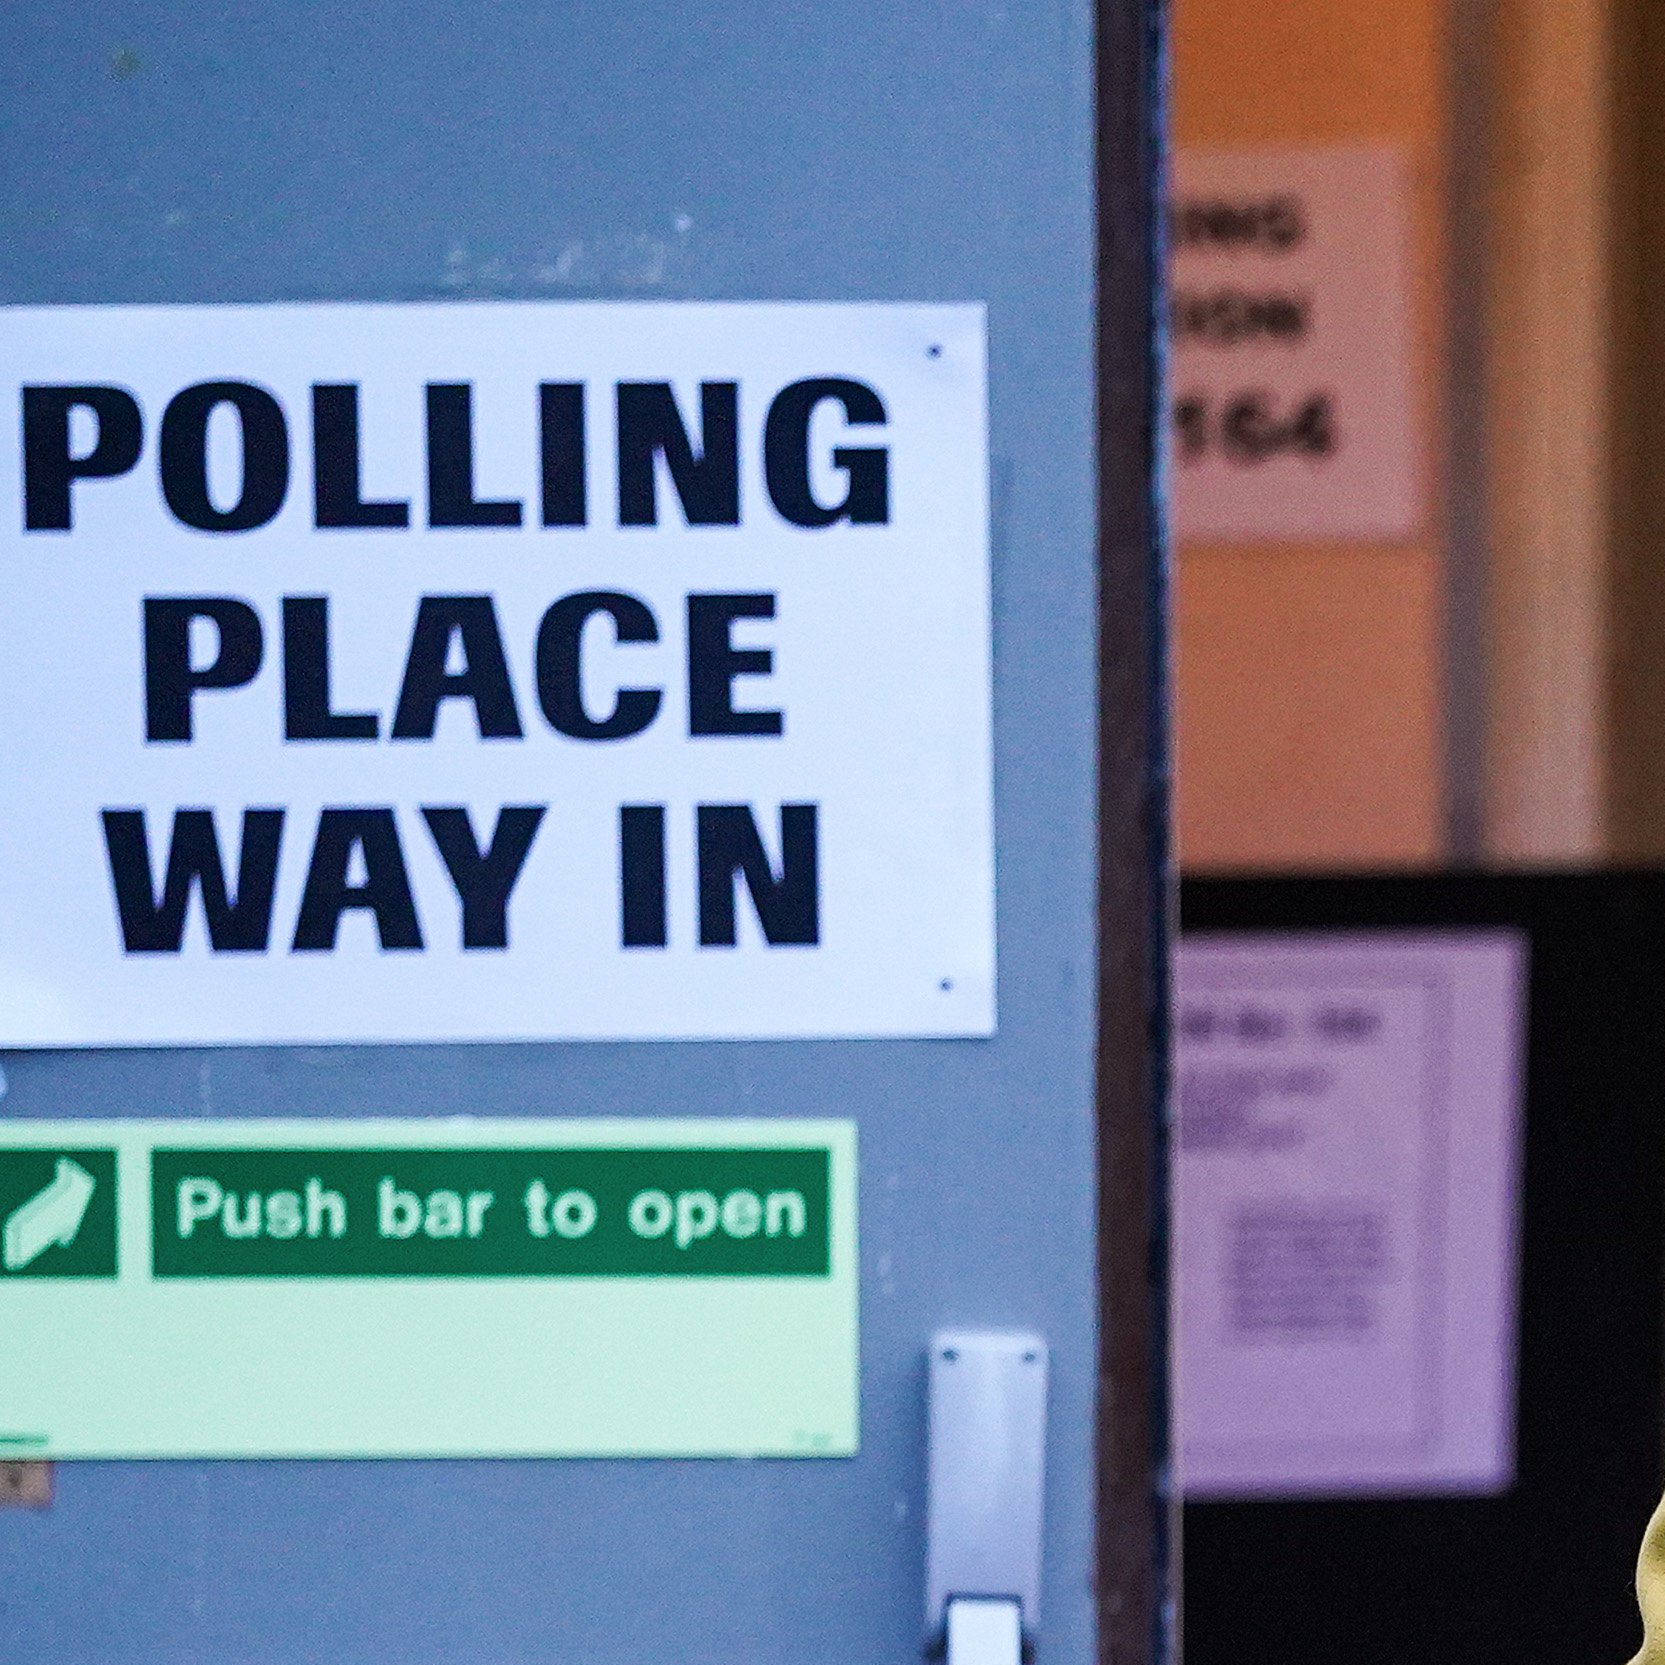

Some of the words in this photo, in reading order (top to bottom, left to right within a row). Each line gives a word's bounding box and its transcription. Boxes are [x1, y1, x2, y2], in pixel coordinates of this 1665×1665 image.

[20, 376, 891, 535] POLLING
[141, 589, 785, 744] PLACE
[100, 804, 548, 955] WAY
[618, 802, 821, 951] IN
[177, 1178, 347, 1239] Push
[378, 1177, 494, 1239] bar
[525, 1180, 598, 1238] to
[628, 1190, 807, 1249] open
